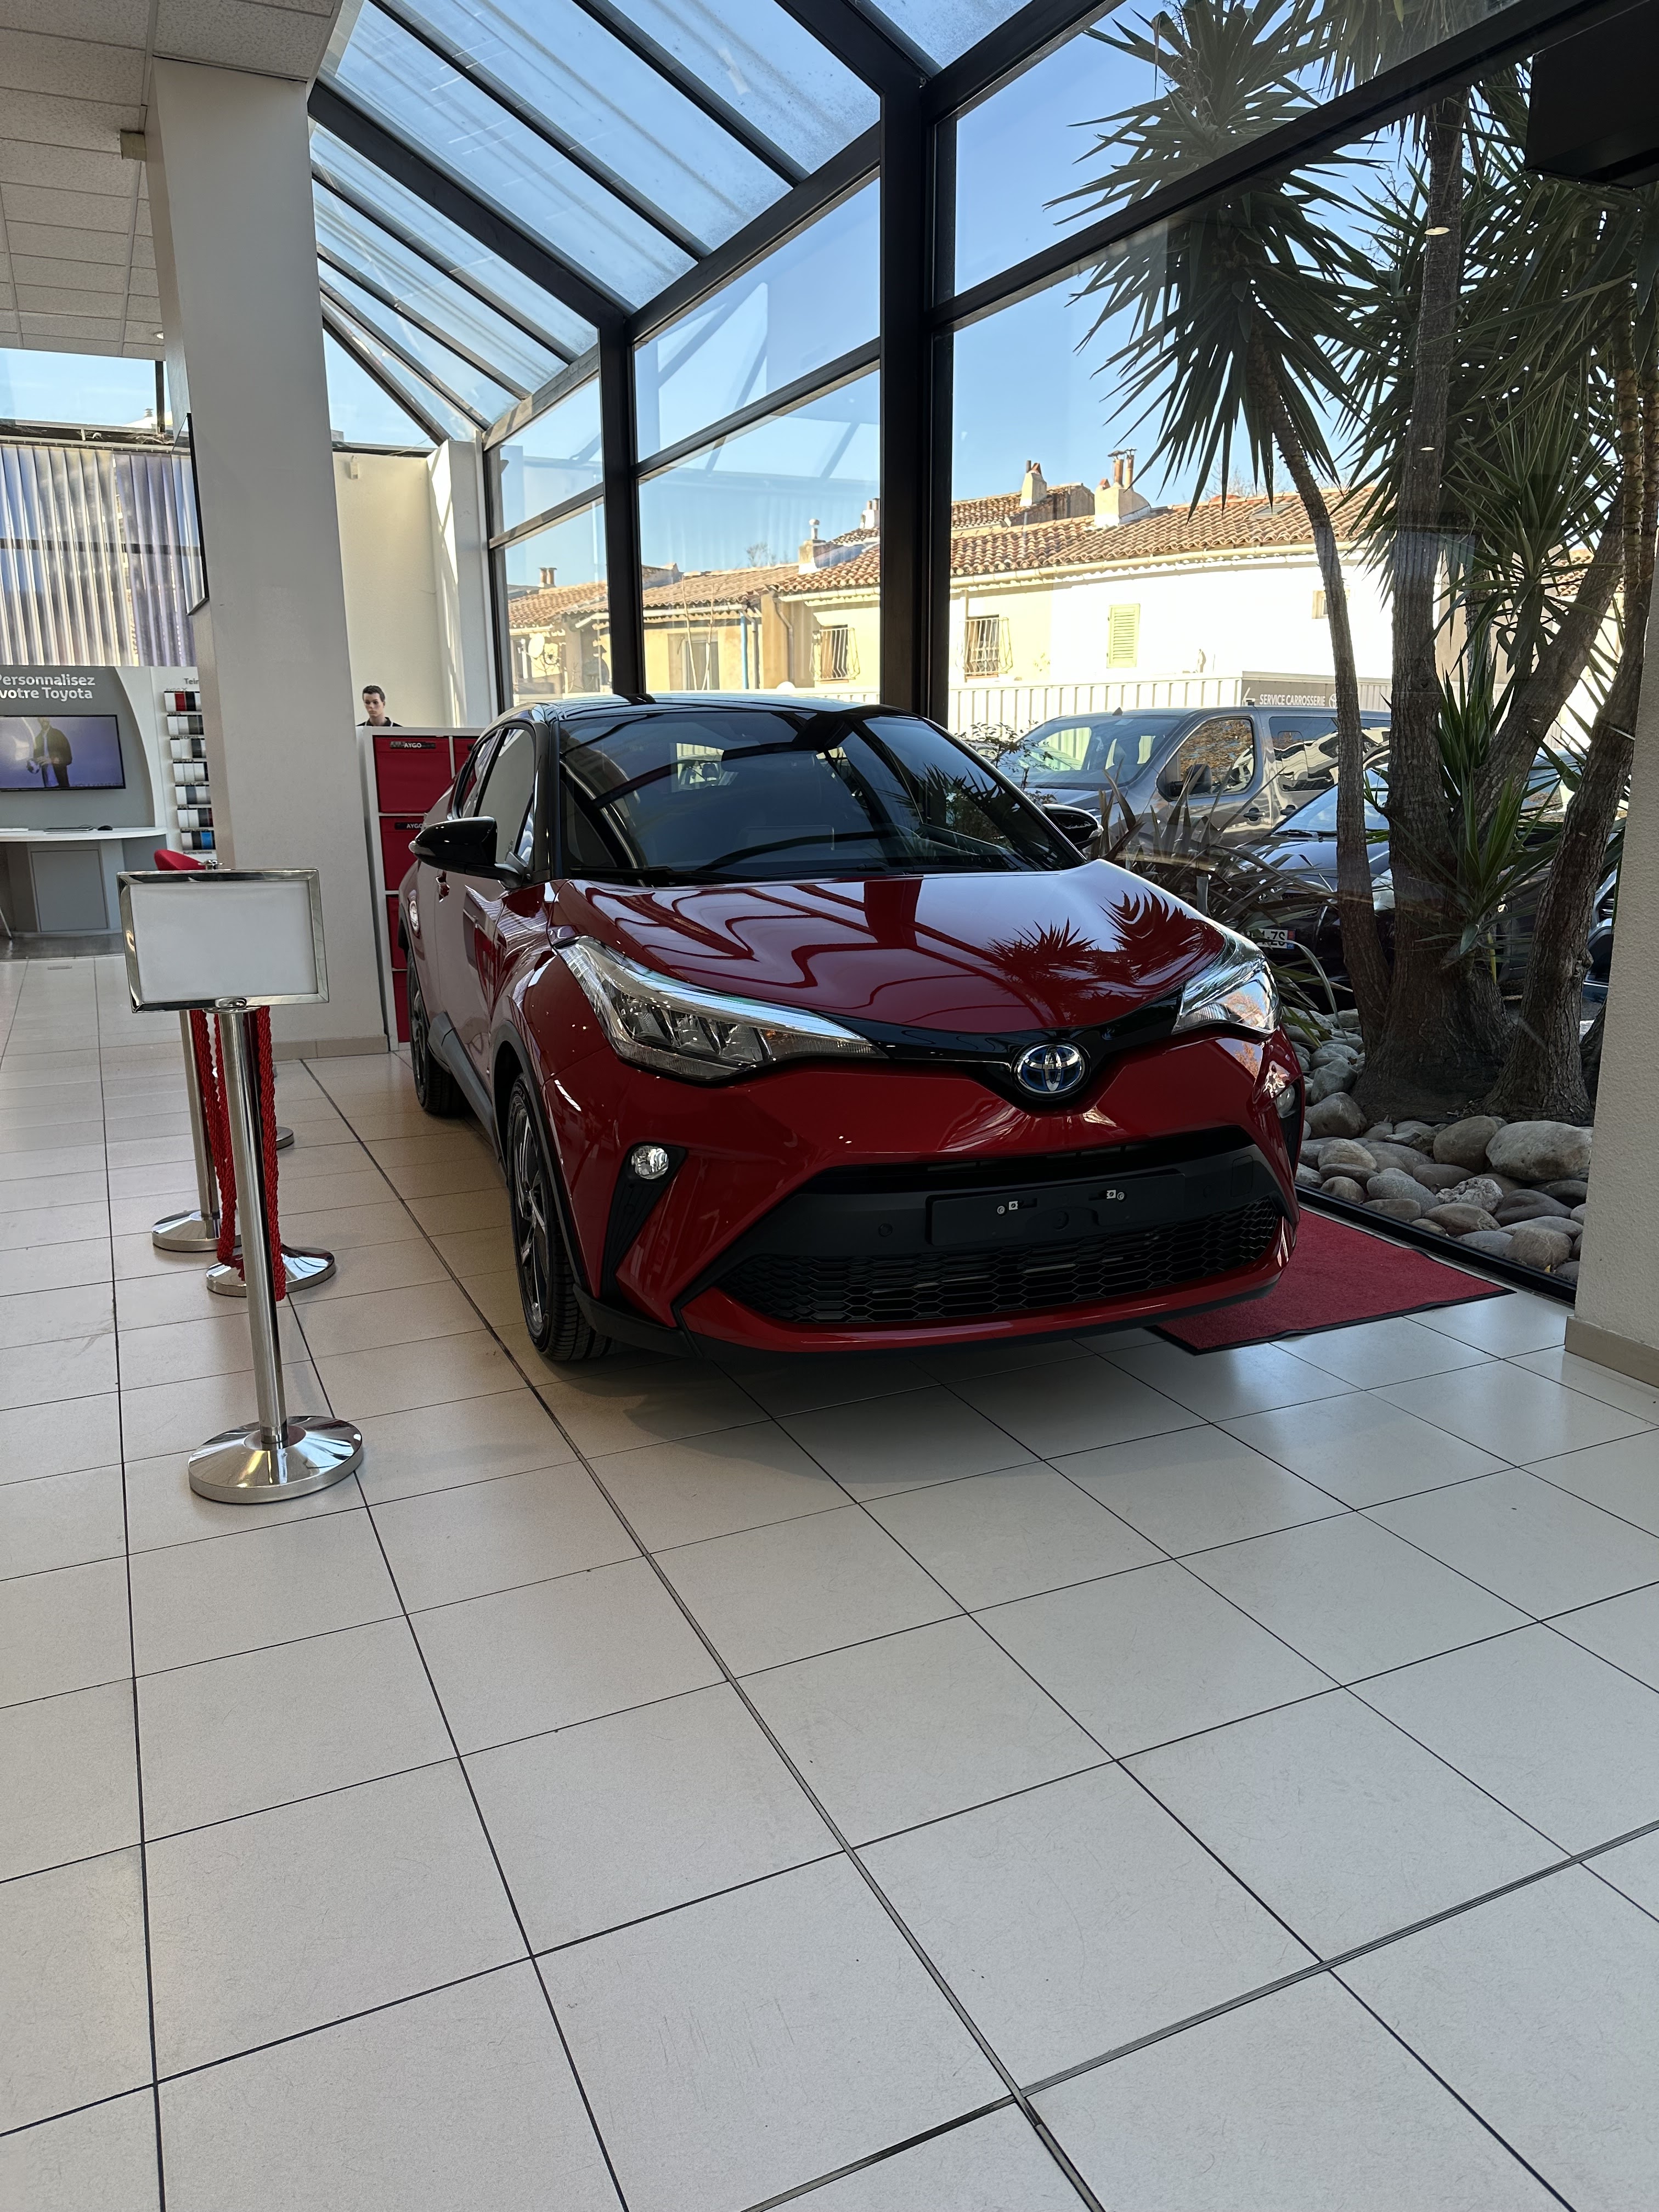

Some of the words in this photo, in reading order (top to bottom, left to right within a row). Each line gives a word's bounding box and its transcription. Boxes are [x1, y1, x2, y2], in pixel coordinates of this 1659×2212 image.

[0, 674, 95, 686] ersonnalisez
[0, 688, 40, 699] votre
[41, 687, 93, 702] Toyota
[1260, 694, 1285, 706] SERVICE
[1286, 695, 1325, 706] CARROSSERIE
